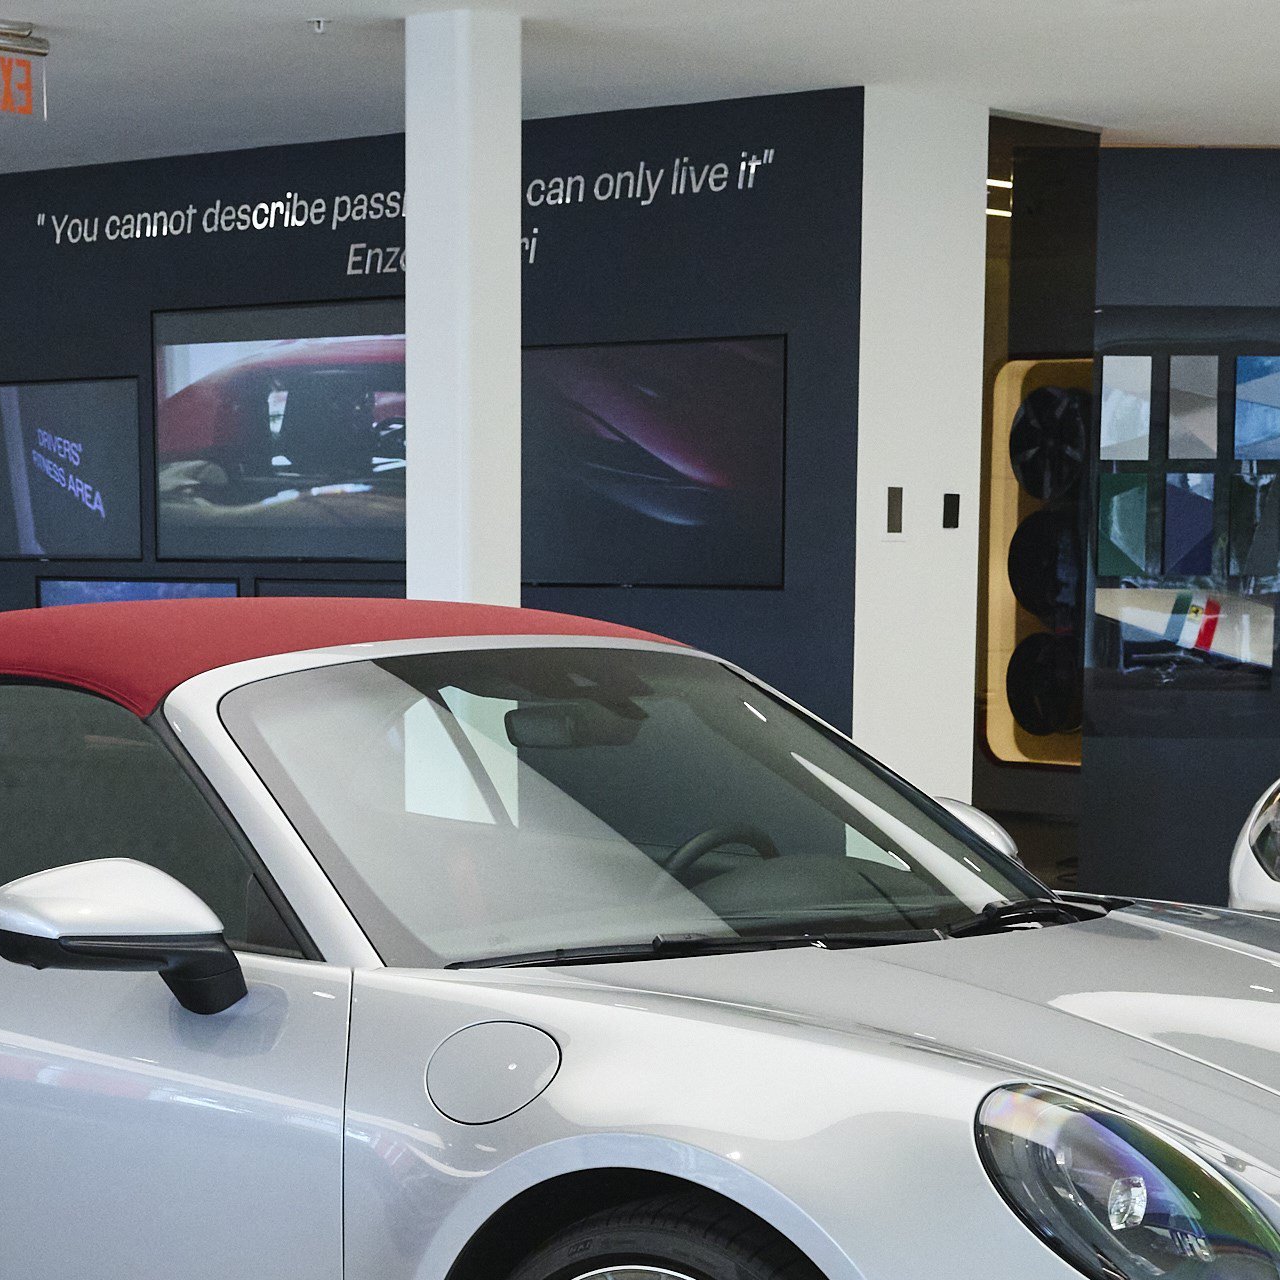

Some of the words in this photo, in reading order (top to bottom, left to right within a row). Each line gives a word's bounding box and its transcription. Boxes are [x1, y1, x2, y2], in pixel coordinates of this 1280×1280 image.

[105, 203, 198, 240] cannot
[202, 191, 326, 233] describe
[526, 174, 585, 207] can
[593, 160, 665, 206] only
[671, 156, 729, 195] live
[737, 149, 775, 190] it"
[68, 473, 106, 518] AREA
